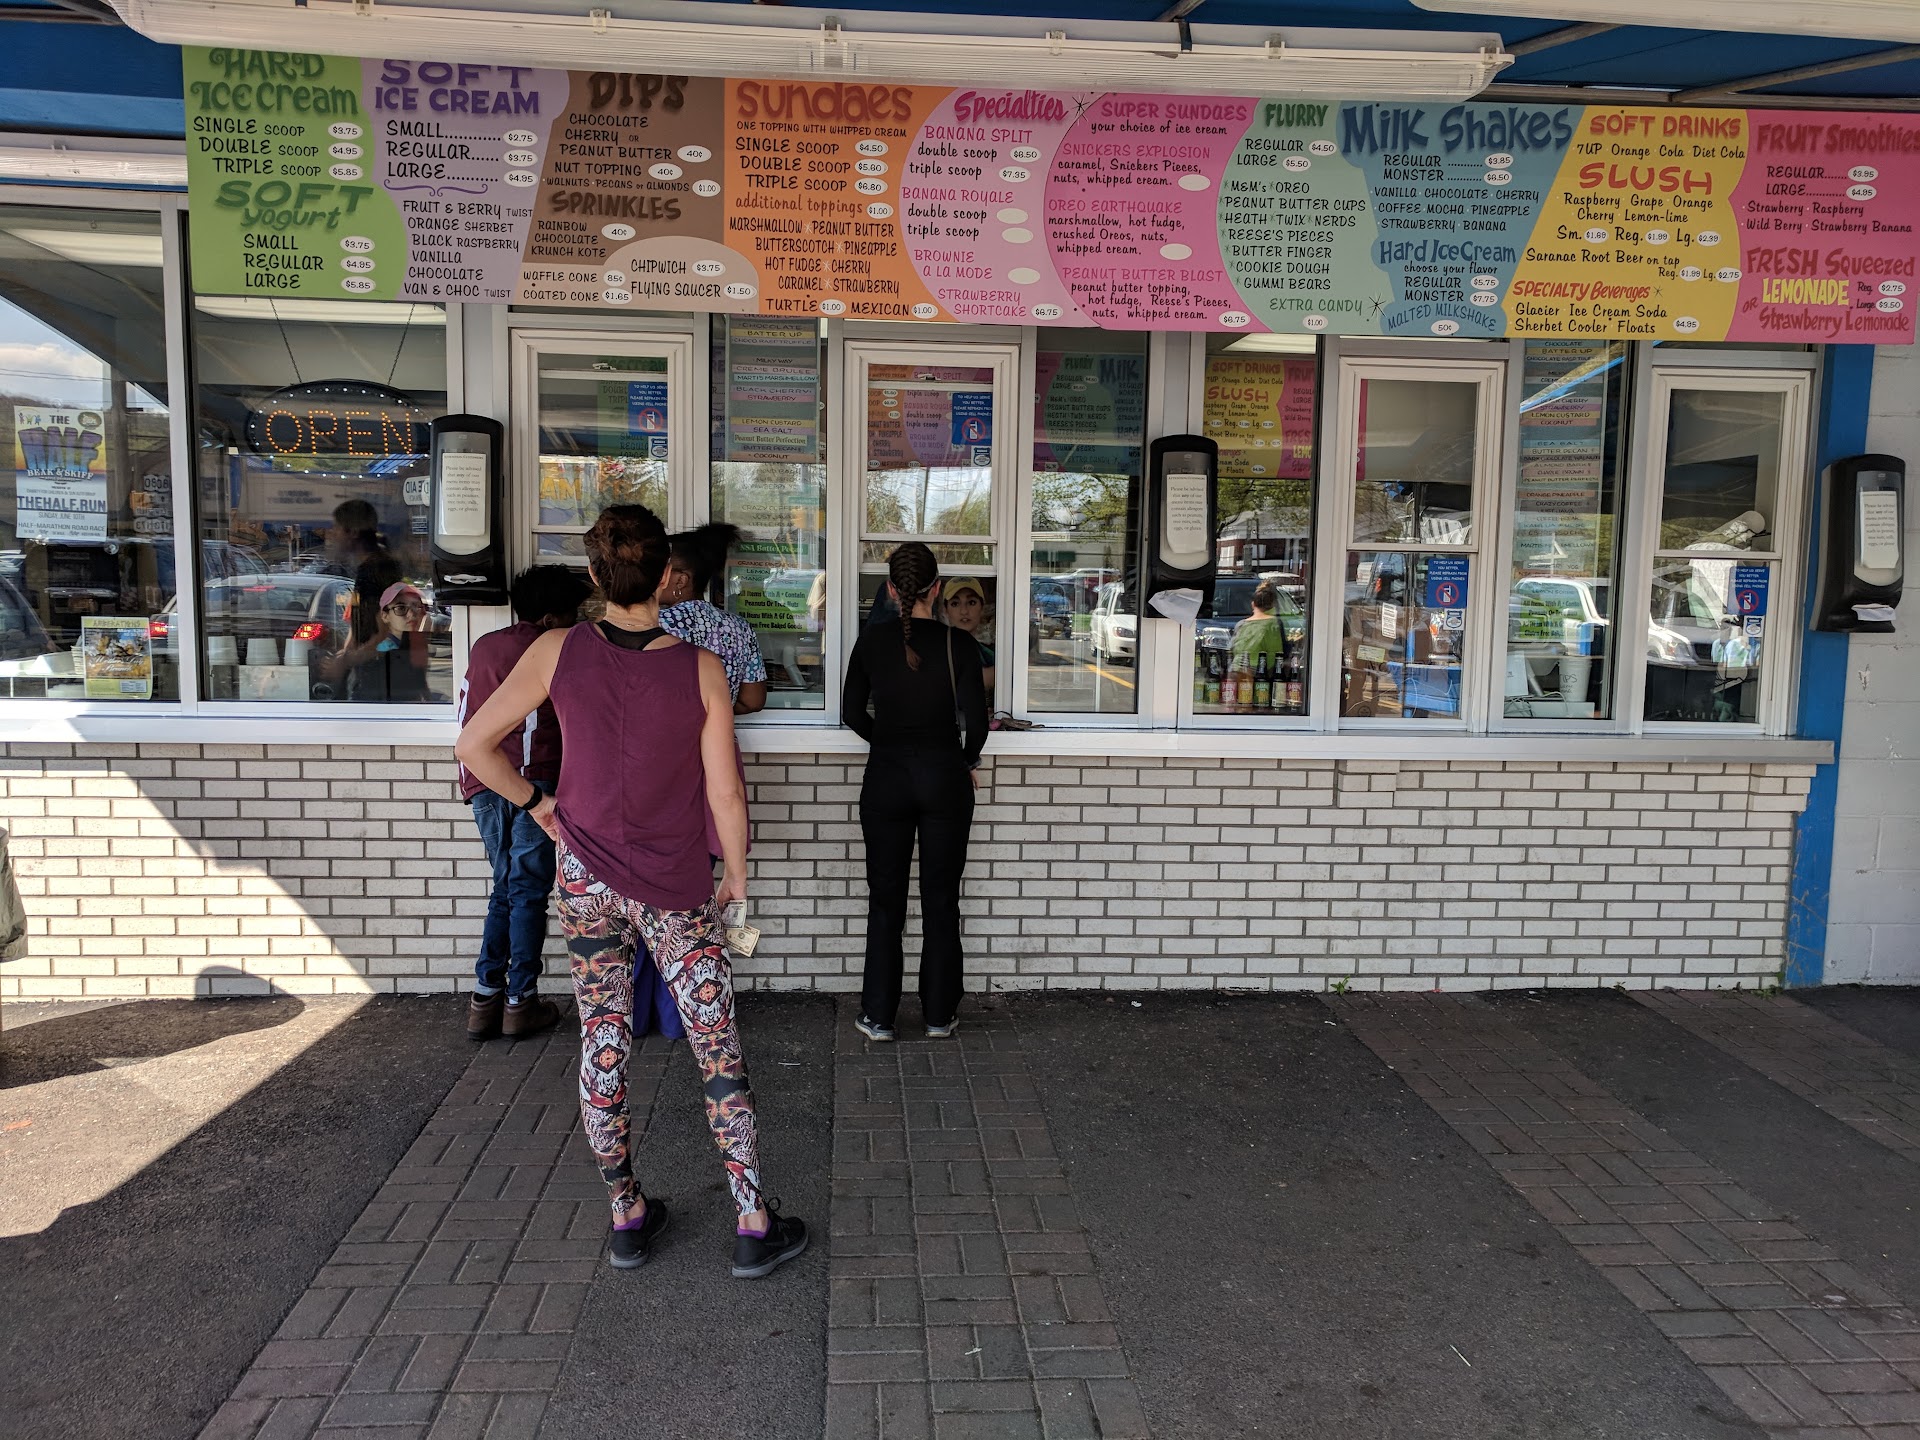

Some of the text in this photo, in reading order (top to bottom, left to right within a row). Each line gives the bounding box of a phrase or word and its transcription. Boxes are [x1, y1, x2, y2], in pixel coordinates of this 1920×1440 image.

[209, 48, 324, 81] HARD
[381, 59, 532, 88] SOFT
[256, 83, 359, 115] Cream
[589, 73, 689, 110] DIPS
[375, 87, 539, 114] ICE CREAM
[954, 90, 1069, 122] Specialties
[1101, 102, 1247, 121] SUPER SUNDAES
[1265, 104, 1328, 128] FLURRY
[193, 117, 358, 136] SINGLE SCOOP $3.75
[570, 113, 648, 128] CHOCOLATE
[737, 121, 907, 137] ONE TOPPING WITH WHIPPED CREAM
[1091, 121, 1227, 134] your choice of ice cream
[1342, 105, 1573, 153] Milk Shakes
[1590, 114, 1741, 138] SOFT DRINKS
[925, 126, 1032, 143] BANANA SPLIT
[1757, 123, 1920, 154] FRUIT Smoothies
[199, 137, 271, 154] DOUBLE
[278, 145, 319, 157] SCOOP
[560, 144, 613, 157] PEANUT
[619, 147, 672, 160] BUTTER
[918, 142, 997, 162] double scoop
[1063, 143, 1210, 158] SNICKERS EXPLOSION
[1246, 139, 1303, 151] REGULAR
[1577, 144, 1745, 159] 7UP Orange Cola Diet Cola
[212, 158, 321, 176] TRIPLE SCOOP
[1237, 154, 1277, 166] LARGE
[555, 162, 641, 176] NUT TOPPING
[1579, 163, 1712, 195] SLUSH
[215, 181, 374, 212] SOFT
[1375, 187, 1539, 203] VANILLA CHOCOLATE CHERRY
[1564, 193, 1713, 211] Raspberry Grape Orange
[403, 201, 533, 219] FRUIT & BERRY TWIST
[551, 191, 682, 219] SPRINKLES
[736, 192, 862, 218] additional toppings
[1049, 199, 1182, 213] OREO EARTHQUAKE
[240, 207, 342, 230] yogurt
[408, 218, 513, 232] ORANGE SHERBET
[730, 217, 893, 237] MARSHMALLOW PEANUT BUTTER
[1225, 213, 1356, 226] HEATH TWIX NERDS
[1746, 219, 1912, 235] Wild Berry Strawberry Banana
[244, 234, 298, 250] SMALL
[413, 234, 519, 251] BLACK RASPBERRY
[1229, 229, 1334, 242] REESE'S PIECES
[1380, 239, 1516, 264] Hard Ice Cream
[1526, 249, 1680, 268] Saranac Root Beer on tap
[244, 253, 323, 270] REGULAR
[631, 259, 686, 273] CHIPWICH
[1747, 247, 1915, 277] FRESH Squeezed
[246, 273, 300, 288] LARGE
[409, 267, 483, 280] CHOCOLATE
[524, 272, 597, 282] WAFFLE CONE
[631, 282, 721, 298] FLYING SAUCER
[938, 289, 1020, 306] STRAWBERRY
[1513, 281, 1650, 303] SPECIALTY Beverages
[1762, 278, 1849, 305] LEMONADE
[765, 299, 909, 315] TURTLE MEXICAN
[954, 304, 1026, 316] SHORTCAKE
[1743, 297, 1909, 338] OR Strawberry Lemonade
[1208, 386, 1268, 402] SLUSH
[49, 415, 70, 424] THE
[266, 410, 412, 456] OPEN
[17, 496, 106, 512] THEHALF.RUN
